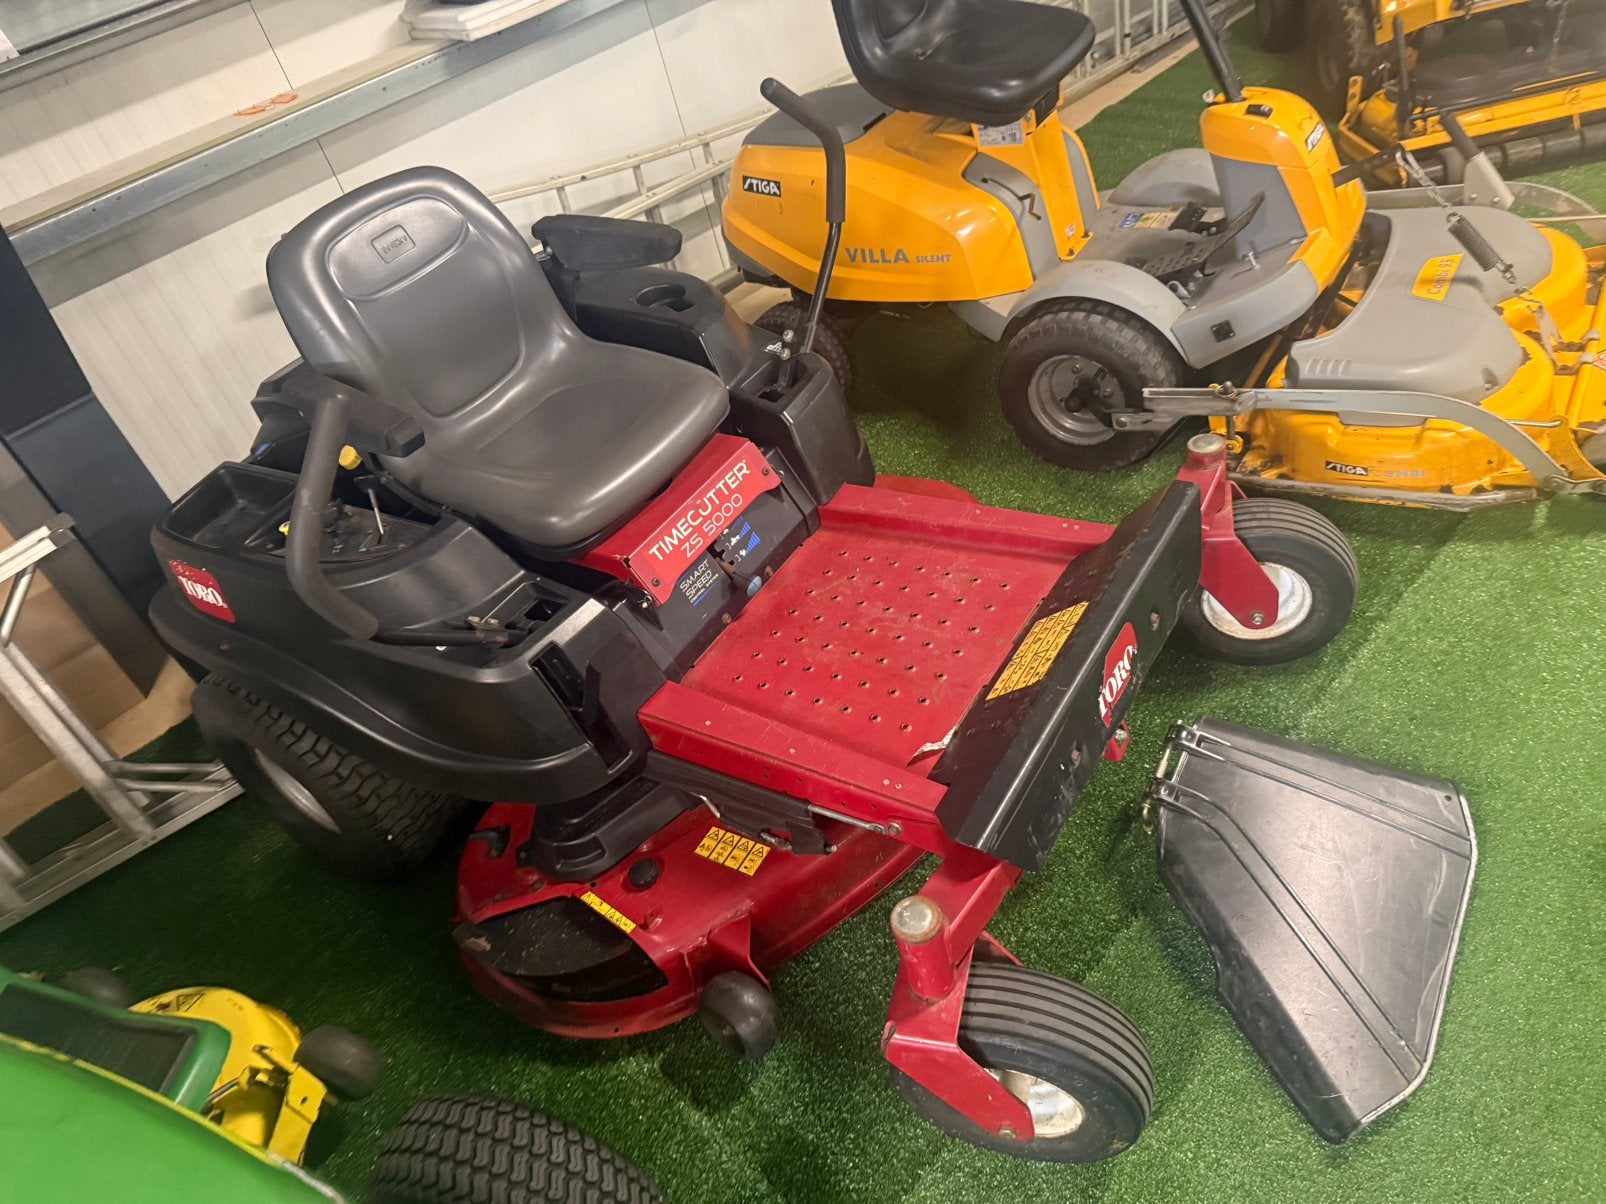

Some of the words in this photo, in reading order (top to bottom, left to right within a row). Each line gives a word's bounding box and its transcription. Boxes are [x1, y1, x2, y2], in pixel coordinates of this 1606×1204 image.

[744, 178, 780, 196] STIGA
[845, 247, 910, 265] VILLA
[915, 253, 952, 264] SILENT
[1427, 269, 1450, 296] Combi
[1326, 462, 1368, 476] STIGA
[649, 461, 751, 561] TIMECUTTER
[680, 533, 704, 559] ZS
[702, 493, 743, 538] 5000
[177, 575, 223, 607] TORO
[680, 558, 709, 593] SMART
[685, 569, 712, 600] SPEED
[1097, 645, 1134, 717] TORO
